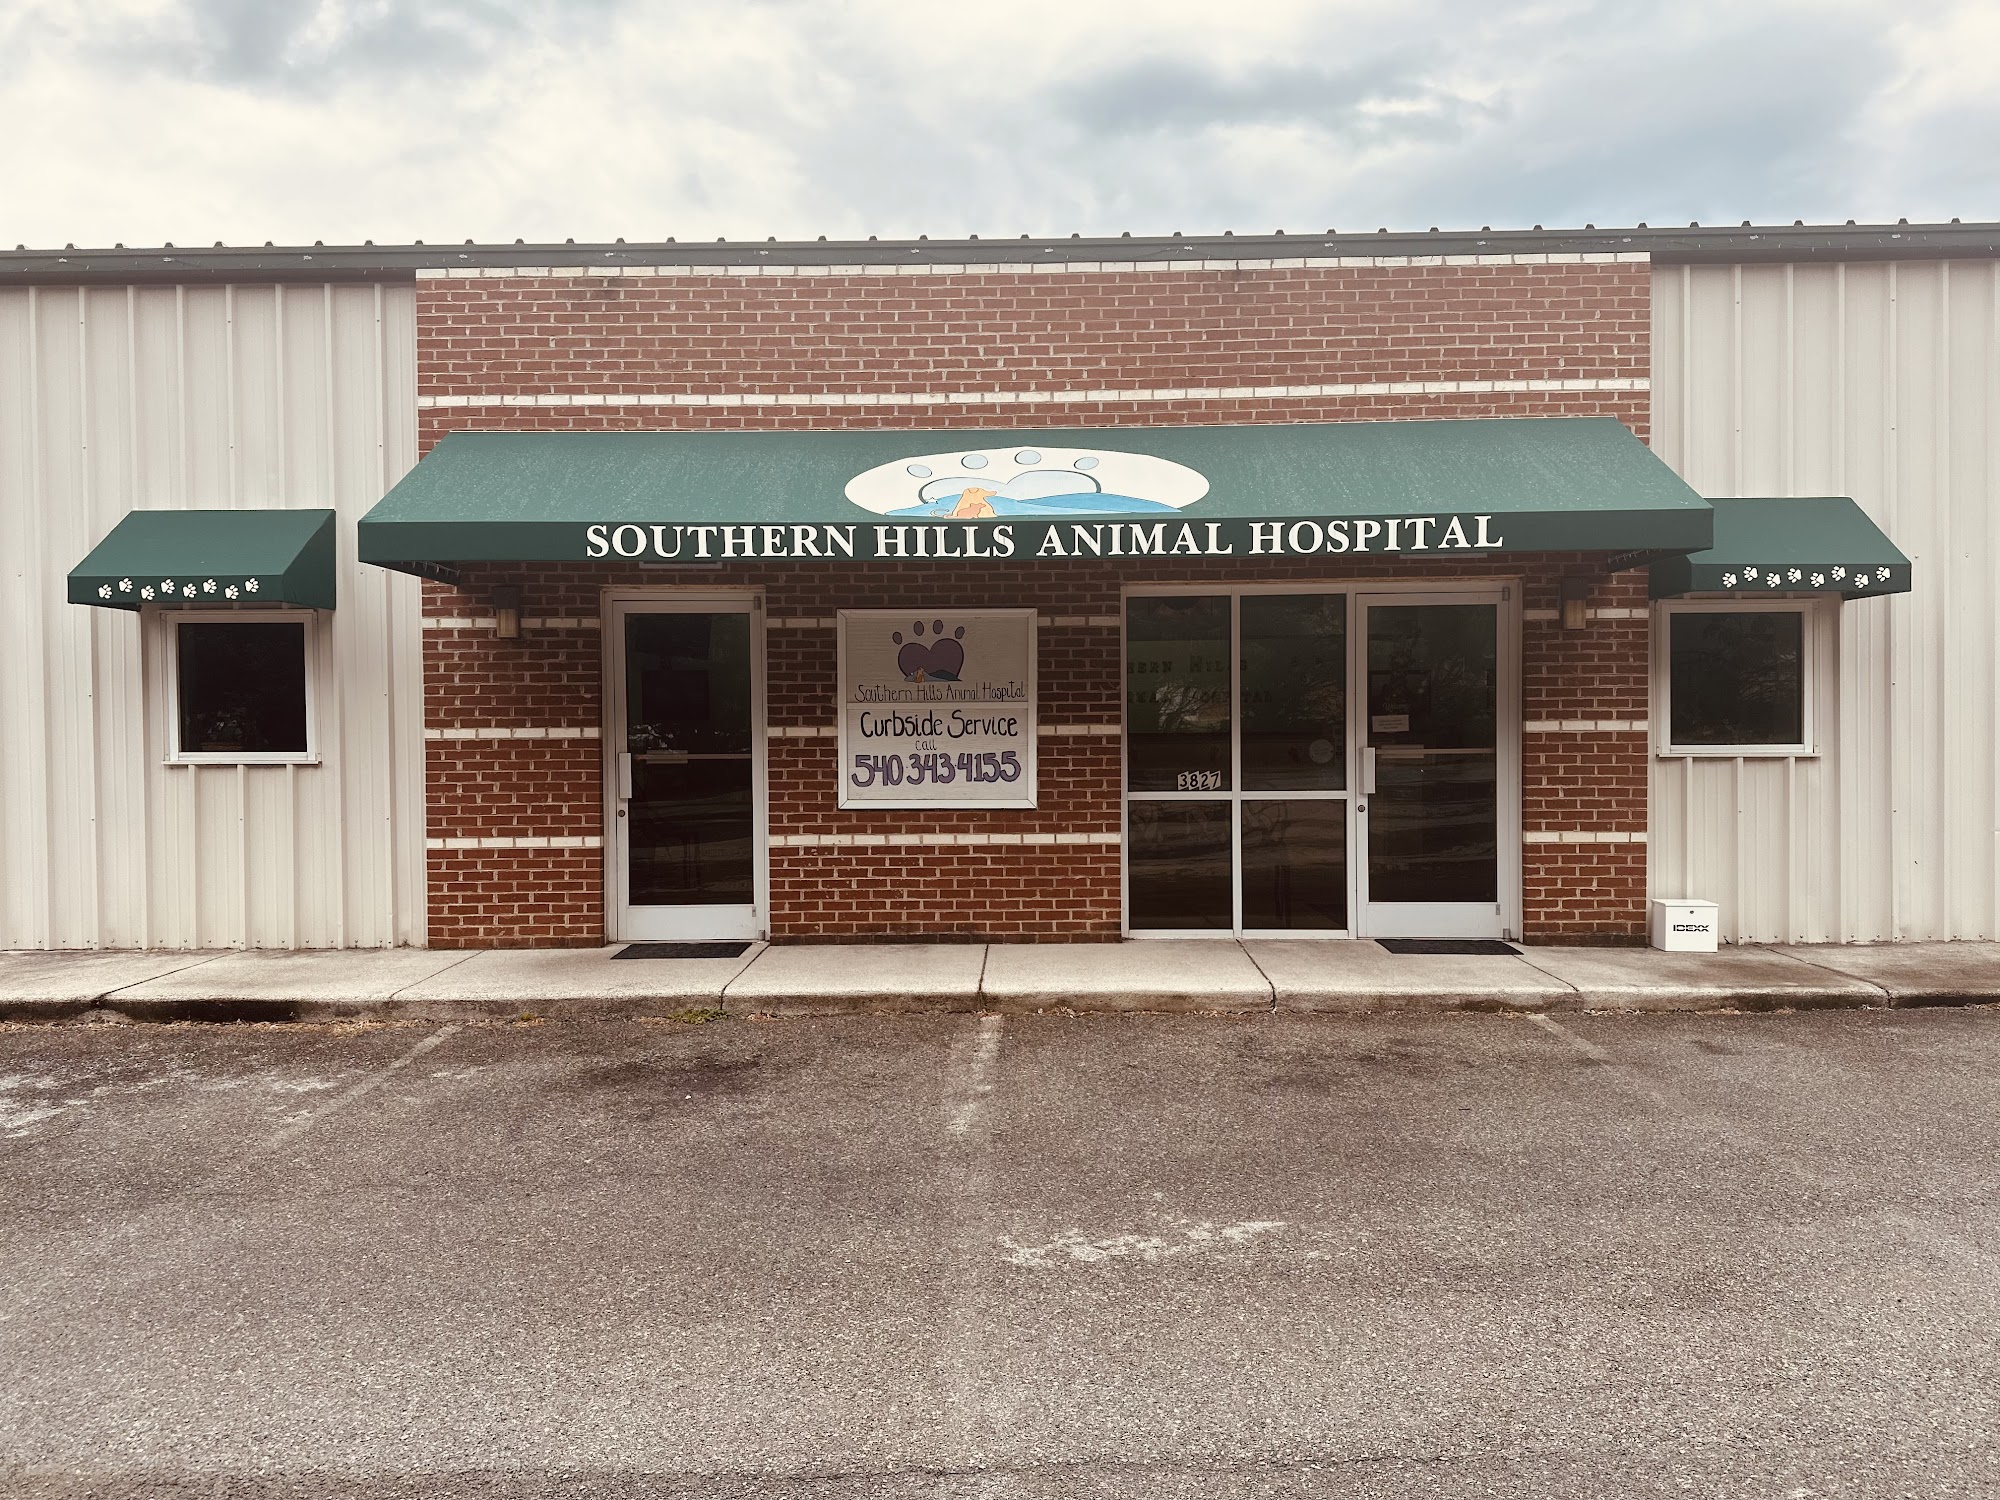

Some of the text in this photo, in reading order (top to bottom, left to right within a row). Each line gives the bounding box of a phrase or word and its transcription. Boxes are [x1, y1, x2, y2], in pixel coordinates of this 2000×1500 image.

[586, 515, 1504, 558] SOUTHERN HILLS ANIMAL HOSPITAL
[854, 680, 1026, 703] Southern Hills Animal Hospital
[860, 709, 1018, 738] Curbside Service
[1179, 772, 1220, 788] 3827
[1673, 924, 1710, 932] IDEXX
